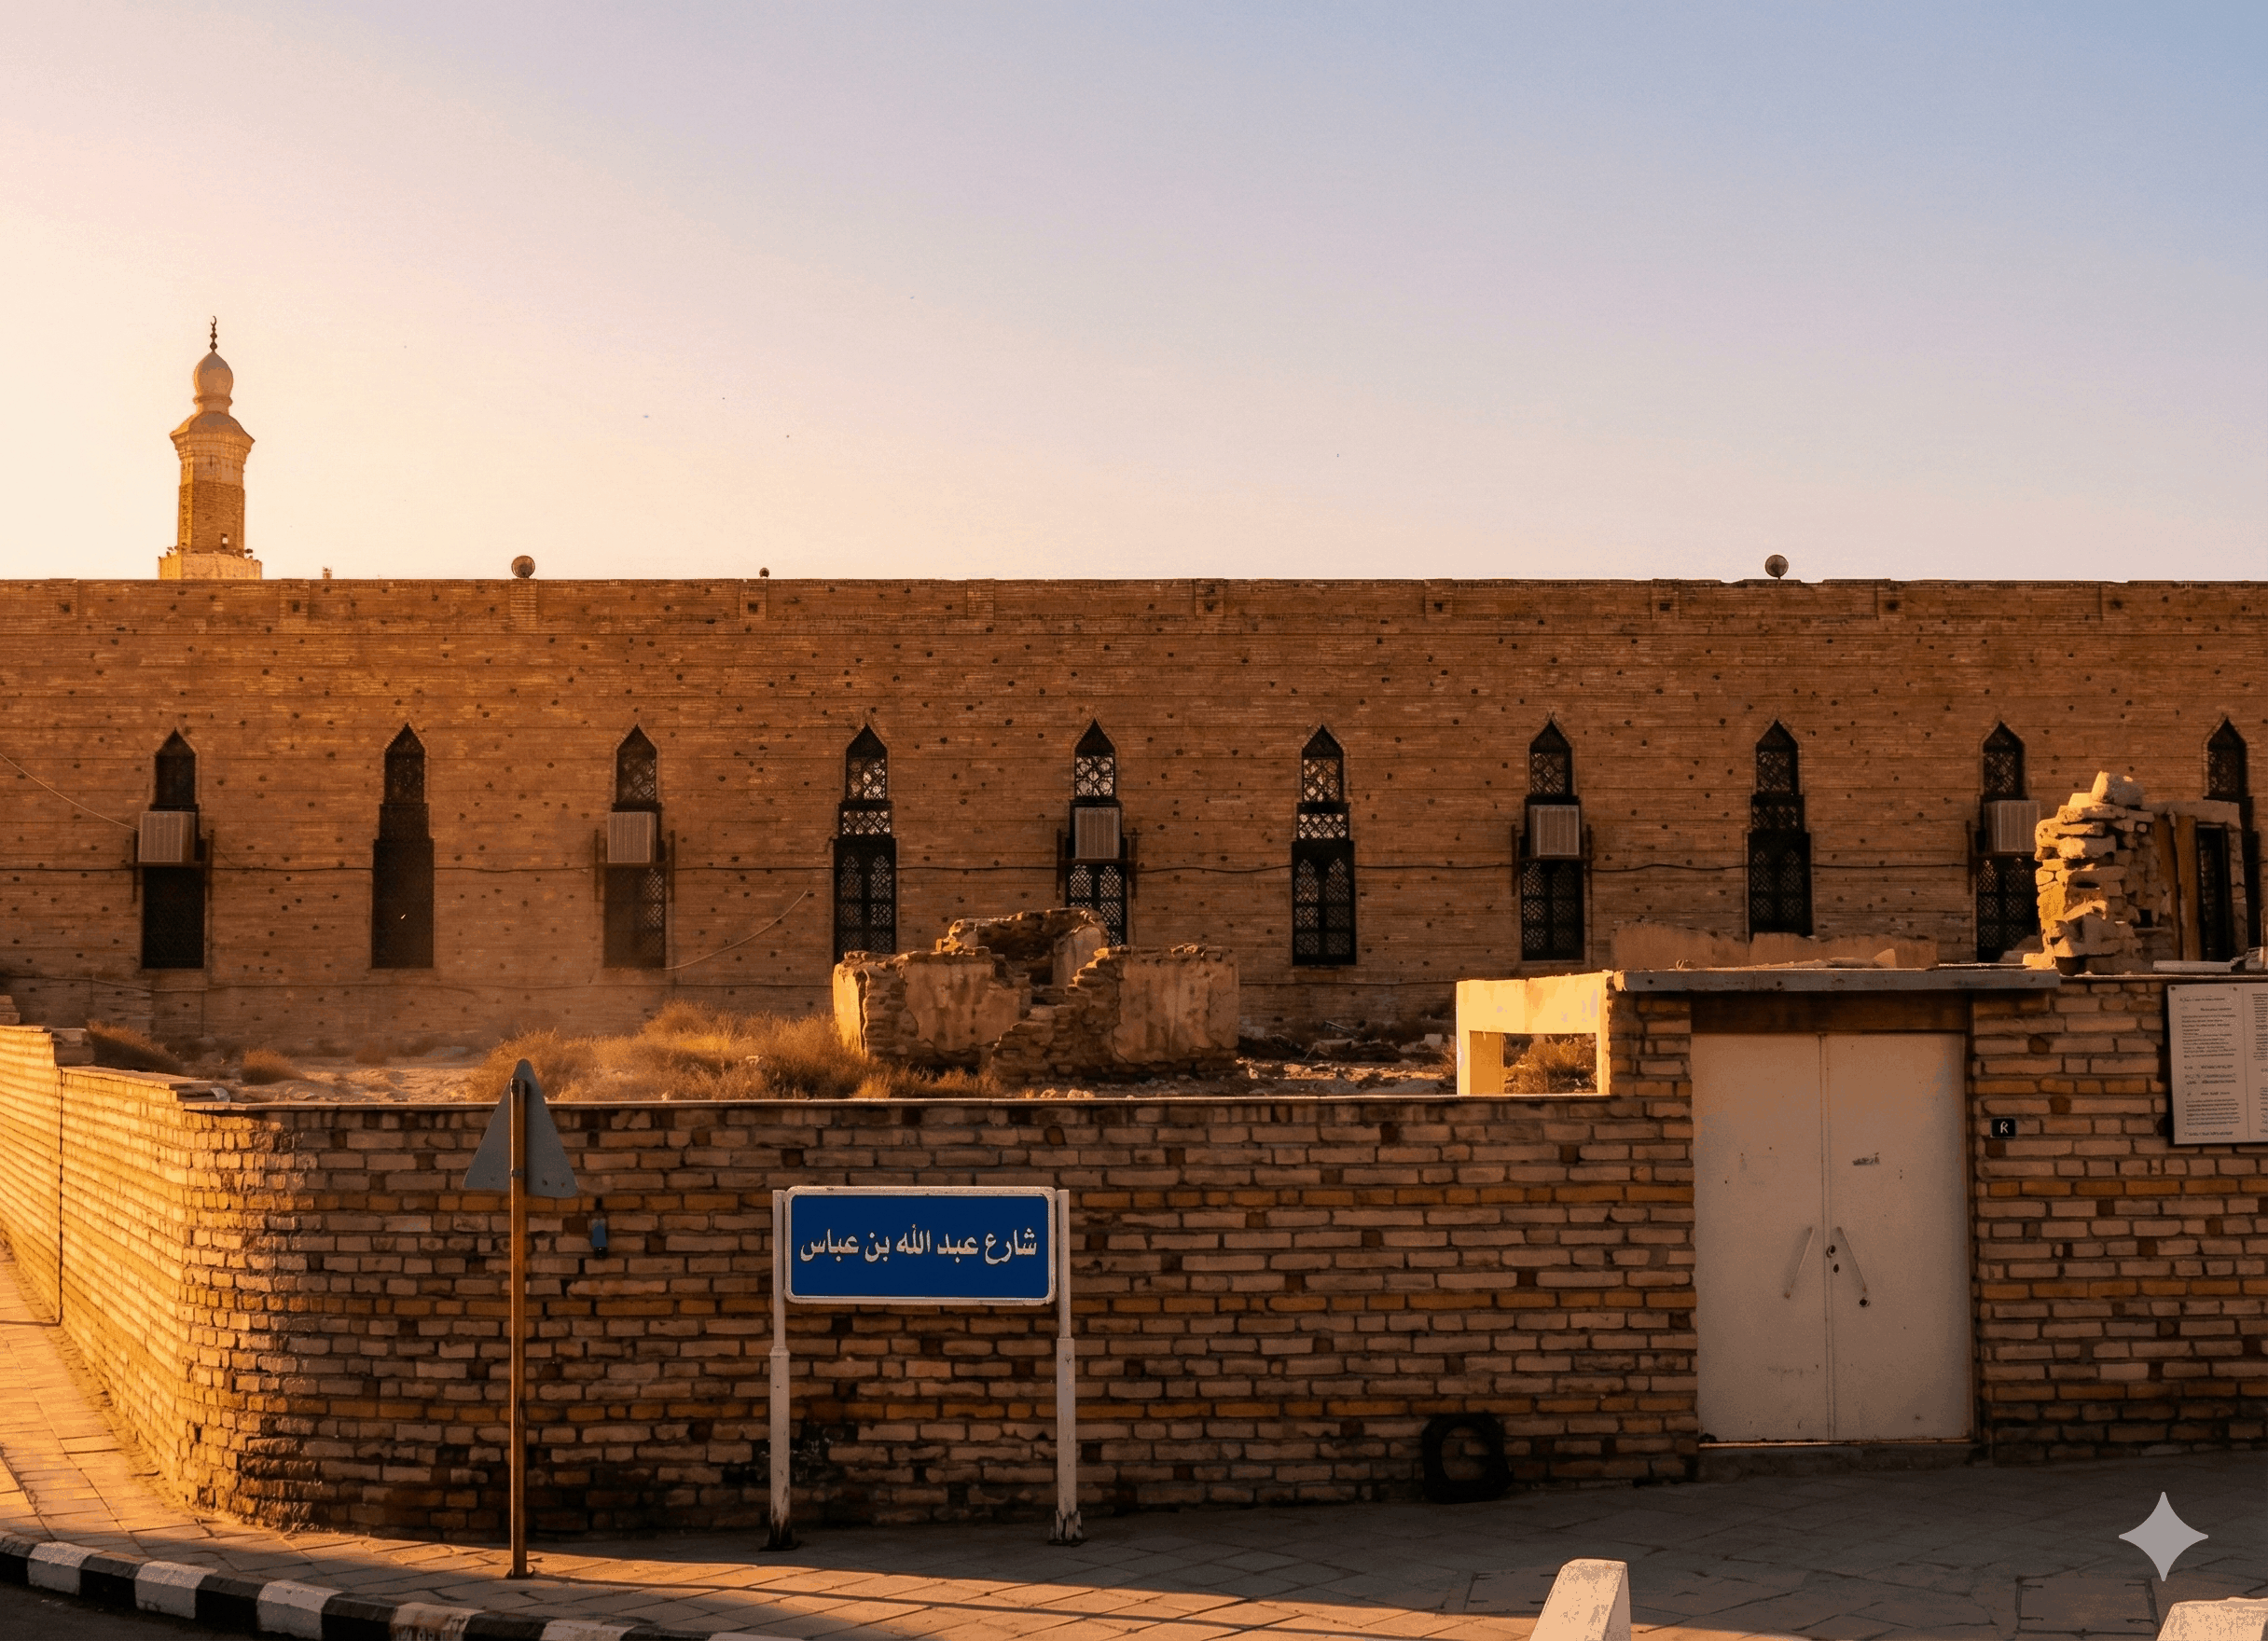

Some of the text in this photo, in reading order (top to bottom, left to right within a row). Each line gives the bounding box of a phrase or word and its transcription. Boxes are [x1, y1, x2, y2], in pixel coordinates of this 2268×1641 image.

[800, 1223, 1037, 1265] شارع عبد الله بن عباس
